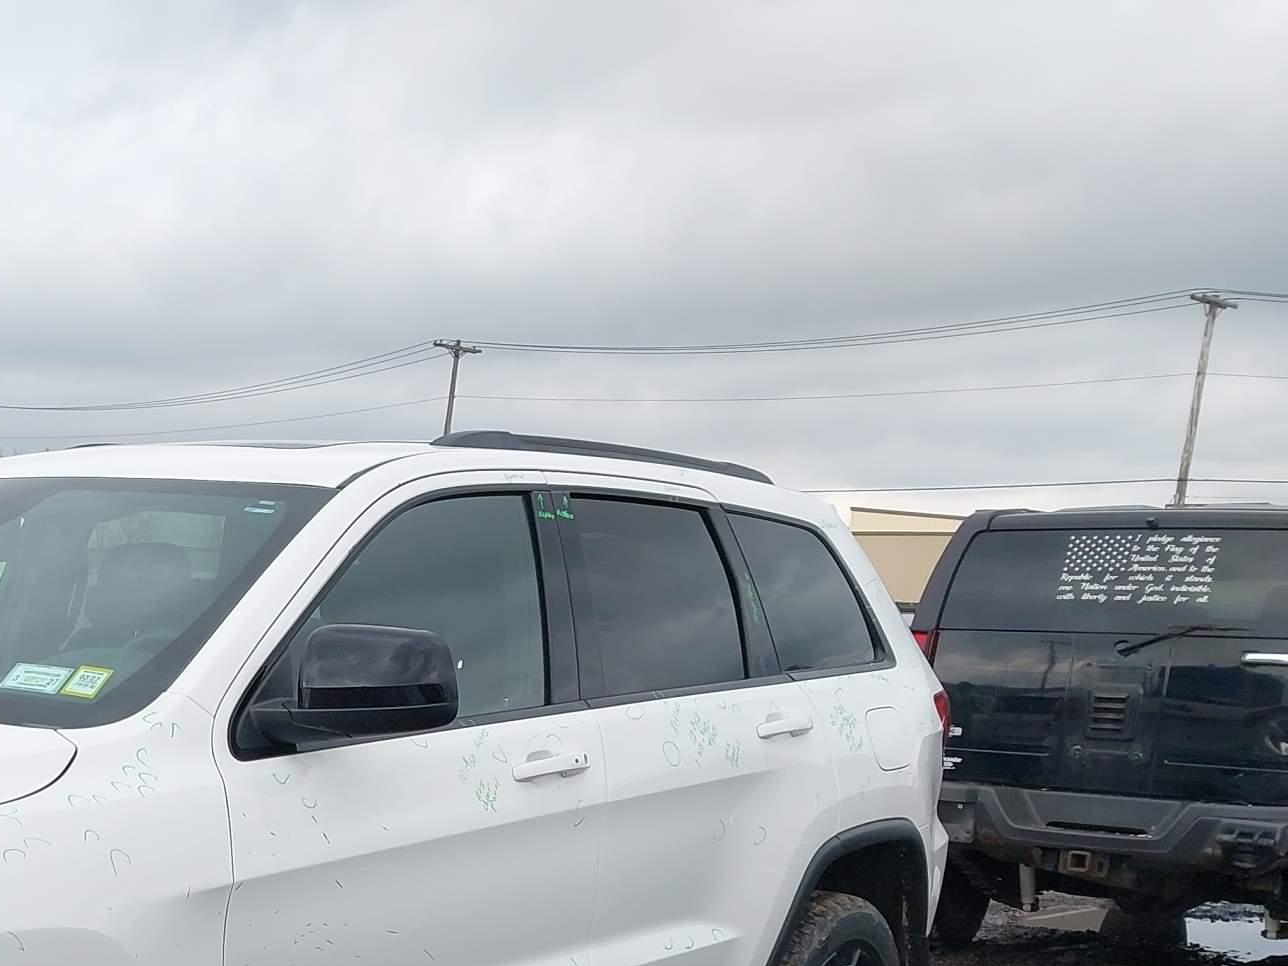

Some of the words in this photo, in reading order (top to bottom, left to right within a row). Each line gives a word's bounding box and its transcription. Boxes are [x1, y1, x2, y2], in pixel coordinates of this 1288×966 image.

[1134, 534, 1142, 542] I
[1146, 534, 1175, 545] pledge
[1180, 534, 1222, 545] allegiance
[1132, 544, 1141, 552] to
[1146, 544, 1160, 552] the
[1164, 544, 1184, 554] Flag
[1189, 544, 1200, 555] of
[1205, 545, 1220, 553] the
[1130, 554, 1159, 562] United
[1168, 554, 1195, 563] States
[1206, 555, 1217, 565] of
[1168, 564, 1188, 572] and
[1188, 564, 1198, 572] to
[1201, 565, 1216, 573] the
[1060, 572, 1093, 583] Republic
[1102, 572, 1119, 583] for
[1128, 573, 1154, 581] which
[1164, 574, 1173, 582] it
[1080, 582, 1108, 591] Nation
[1114, 582, 1140, 591] under
[1080, 592, 1108, 604] liberty
[1113, 593, 1132, 601] and
[1136, 594, 1168, 604] justice
[1173, 594, 1190, 605] for
